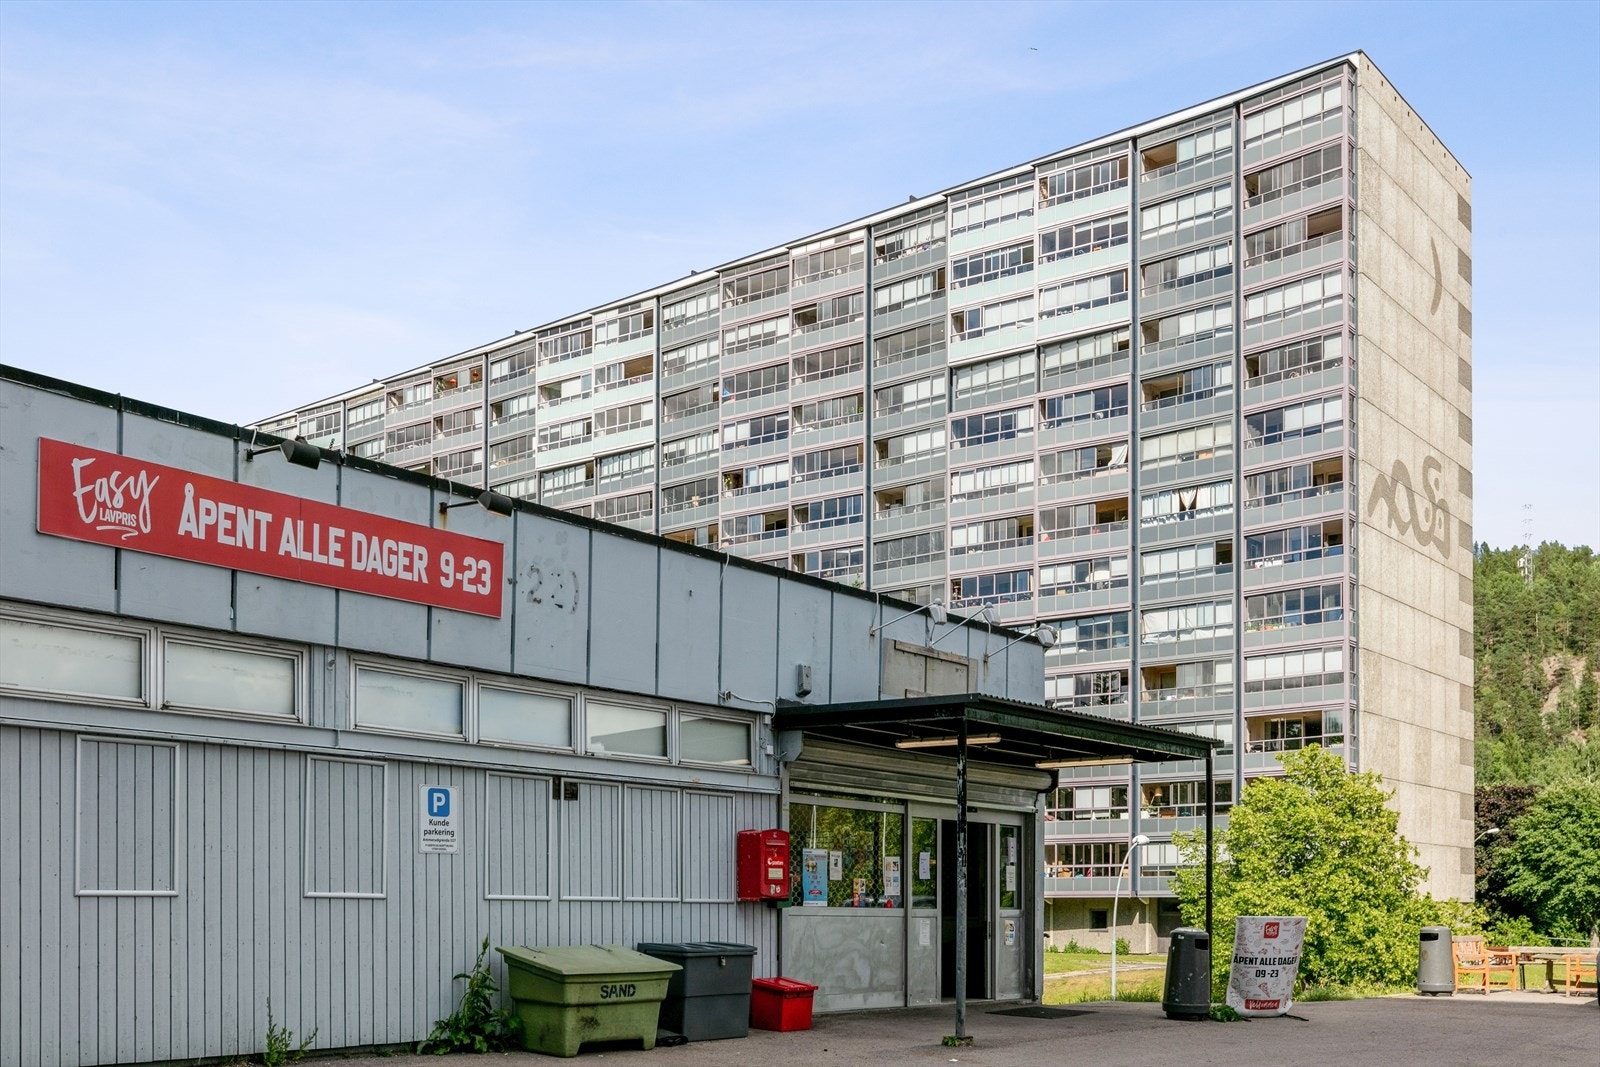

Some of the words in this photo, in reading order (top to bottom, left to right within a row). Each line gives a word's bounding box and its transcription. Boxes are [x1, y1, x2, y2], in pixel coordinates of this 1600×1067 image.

[71, 457, 160, 534] Easy
[99, 507, 137, 527] LAVPRIS
[178, 483, 273, 552] ÅPENT
[278, 517, 345, 568] ALLE
[351, 531, 429, 584] DAGER
[440, 551, 492, 596] 9-23
[433, 793, 445, 812] P
[424, 828, 455, 837] parkering
[1233, 954, 1258, 965] ÅPENT
[1259, 957, 1277, 965] ALLE
[600, 984, 636, 999] SAND
